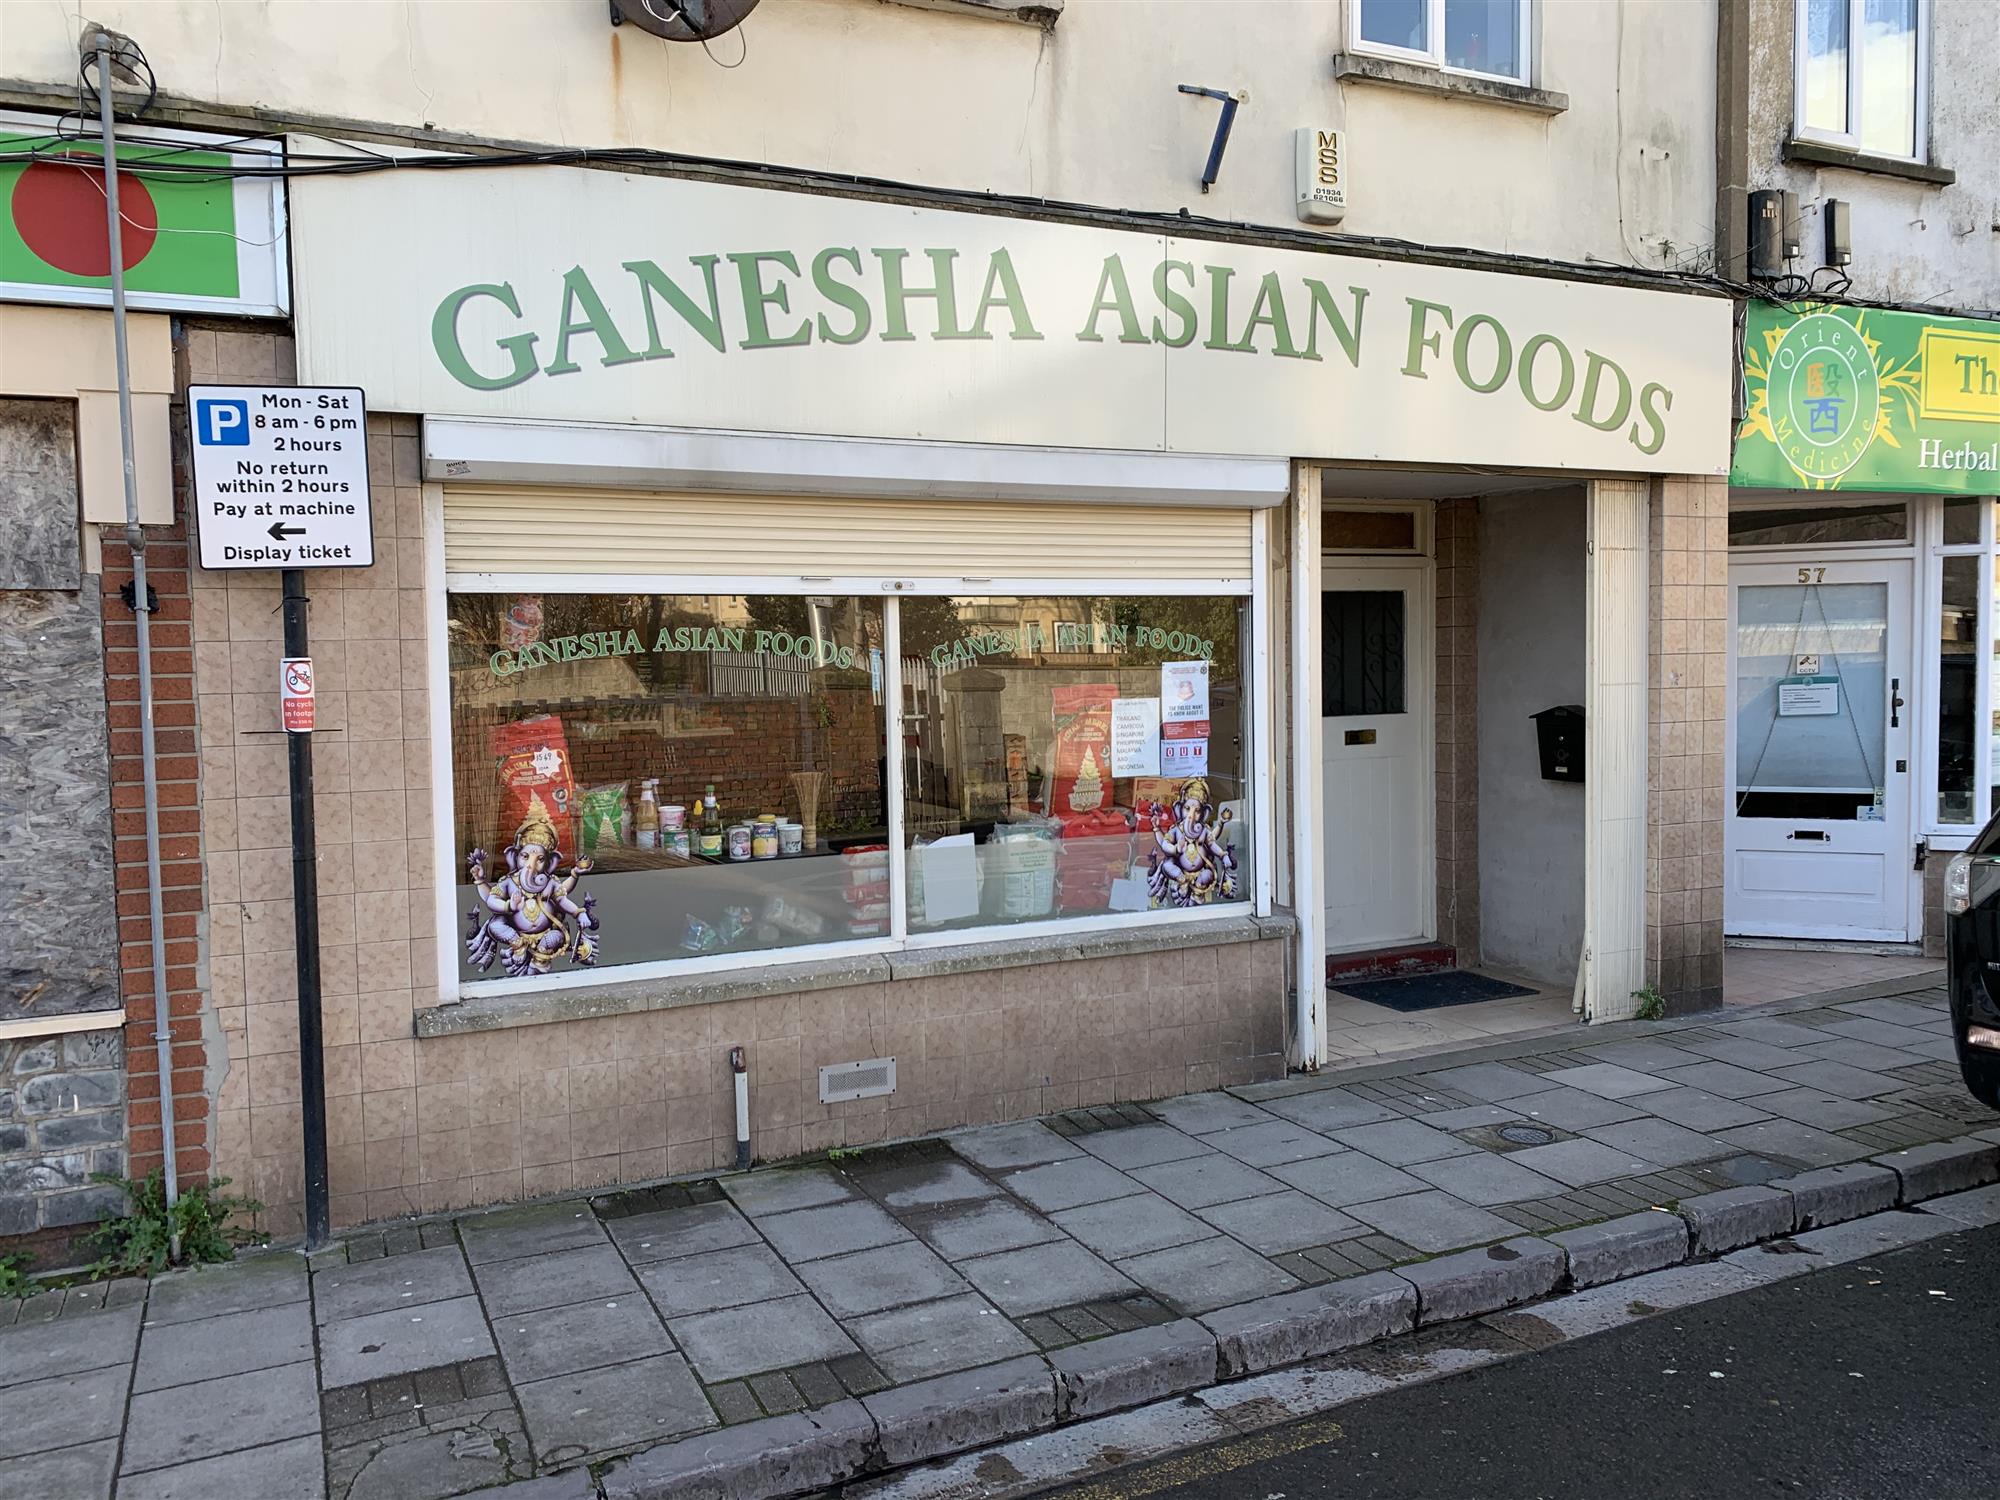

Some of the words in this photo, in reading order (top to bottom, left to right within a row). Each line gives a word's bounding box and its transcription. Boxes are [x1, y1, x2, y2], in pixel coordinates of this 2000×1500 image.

[1318, 131, 1338, 185] MSS
[1314, 194, 1343, 202] 621066
[431, 246, 1044, 391] GANESHA
[1075, 253, 1370, 367] ASIAN
[1400, 296, 1673, 456] FOODS
[1779, 320, 1868, 380] Orient
[1954, 353, 2000, 396] Th
[262, 394, 302, 409] Mon
[317, 395, 349, 409] Sat
[209, 404, 241, 442] P
[254, 415, 266, 428] 8
[271, 417, 299, 429] am
[314, 415, 325, 430] 6
[330, 418, 357, 432] pm
[273, 437, 285, 451] 2
[290, 437, 342, 452] hours
[1775, 415, 1873, 473] Medicine
[1918, 438, 1998, 471] Herbal
[237, 461, 263, 475] No
[271, 462, 328, 475] return
[216, 480, 275, 493] within
[281, 479, 293, 493] 2
[299, 479, 349, 493] hours
[214, 502, 247, 518] Pay
[254, 502, 272, 516] at
[280, 502, 355, 515] machine
[224, 546, 291, 562] Display
[298, 545, 352, 558] ticket
[1798, 567, 1826, 583] 57
[489, 628, 645, 677] GANESHA
[653, 627, 744, 652] ASIAN
[755, 629, 855, 670] FOODS
[930, 626, 1048, 668] GANESHA
[1057, 623, 1128, 647] ASIAN
[1135, 625, 1215, 660] FOODS
